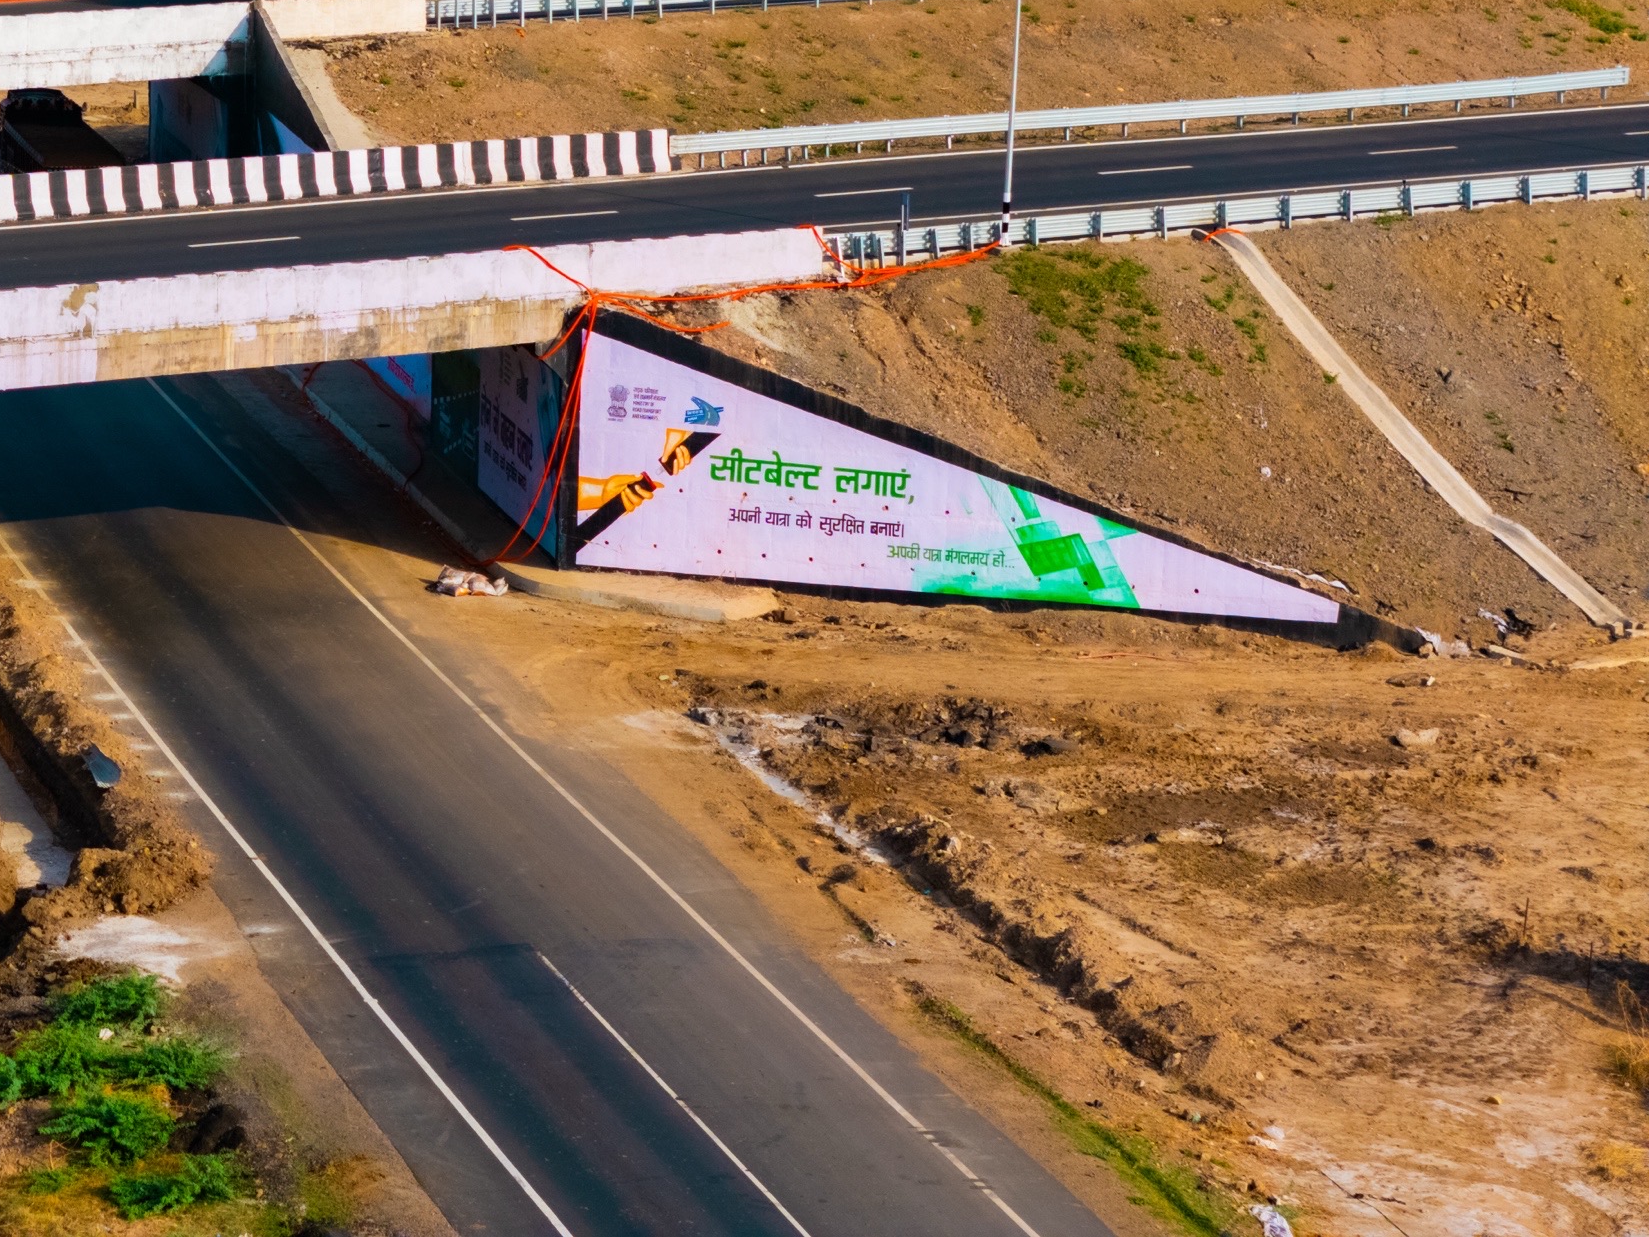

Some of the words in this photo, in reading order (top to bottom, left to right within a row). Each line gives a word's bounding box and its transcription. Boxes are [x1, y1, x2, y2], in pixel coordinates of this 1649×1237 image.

[709, 448, 822, 491] सीटबेल्ट
[833, 466, 915, 505] लगाएं,
[728, 506, 761, 525] अपनी
[765, 511, 791, 527] यात्रा
[795, 510, 812, 529] को
[819, 513, 865, 536] सुरक्षित
[923, 548, 942, 562] यात्रा
[945, 548, 989, 566] मंगलमय
